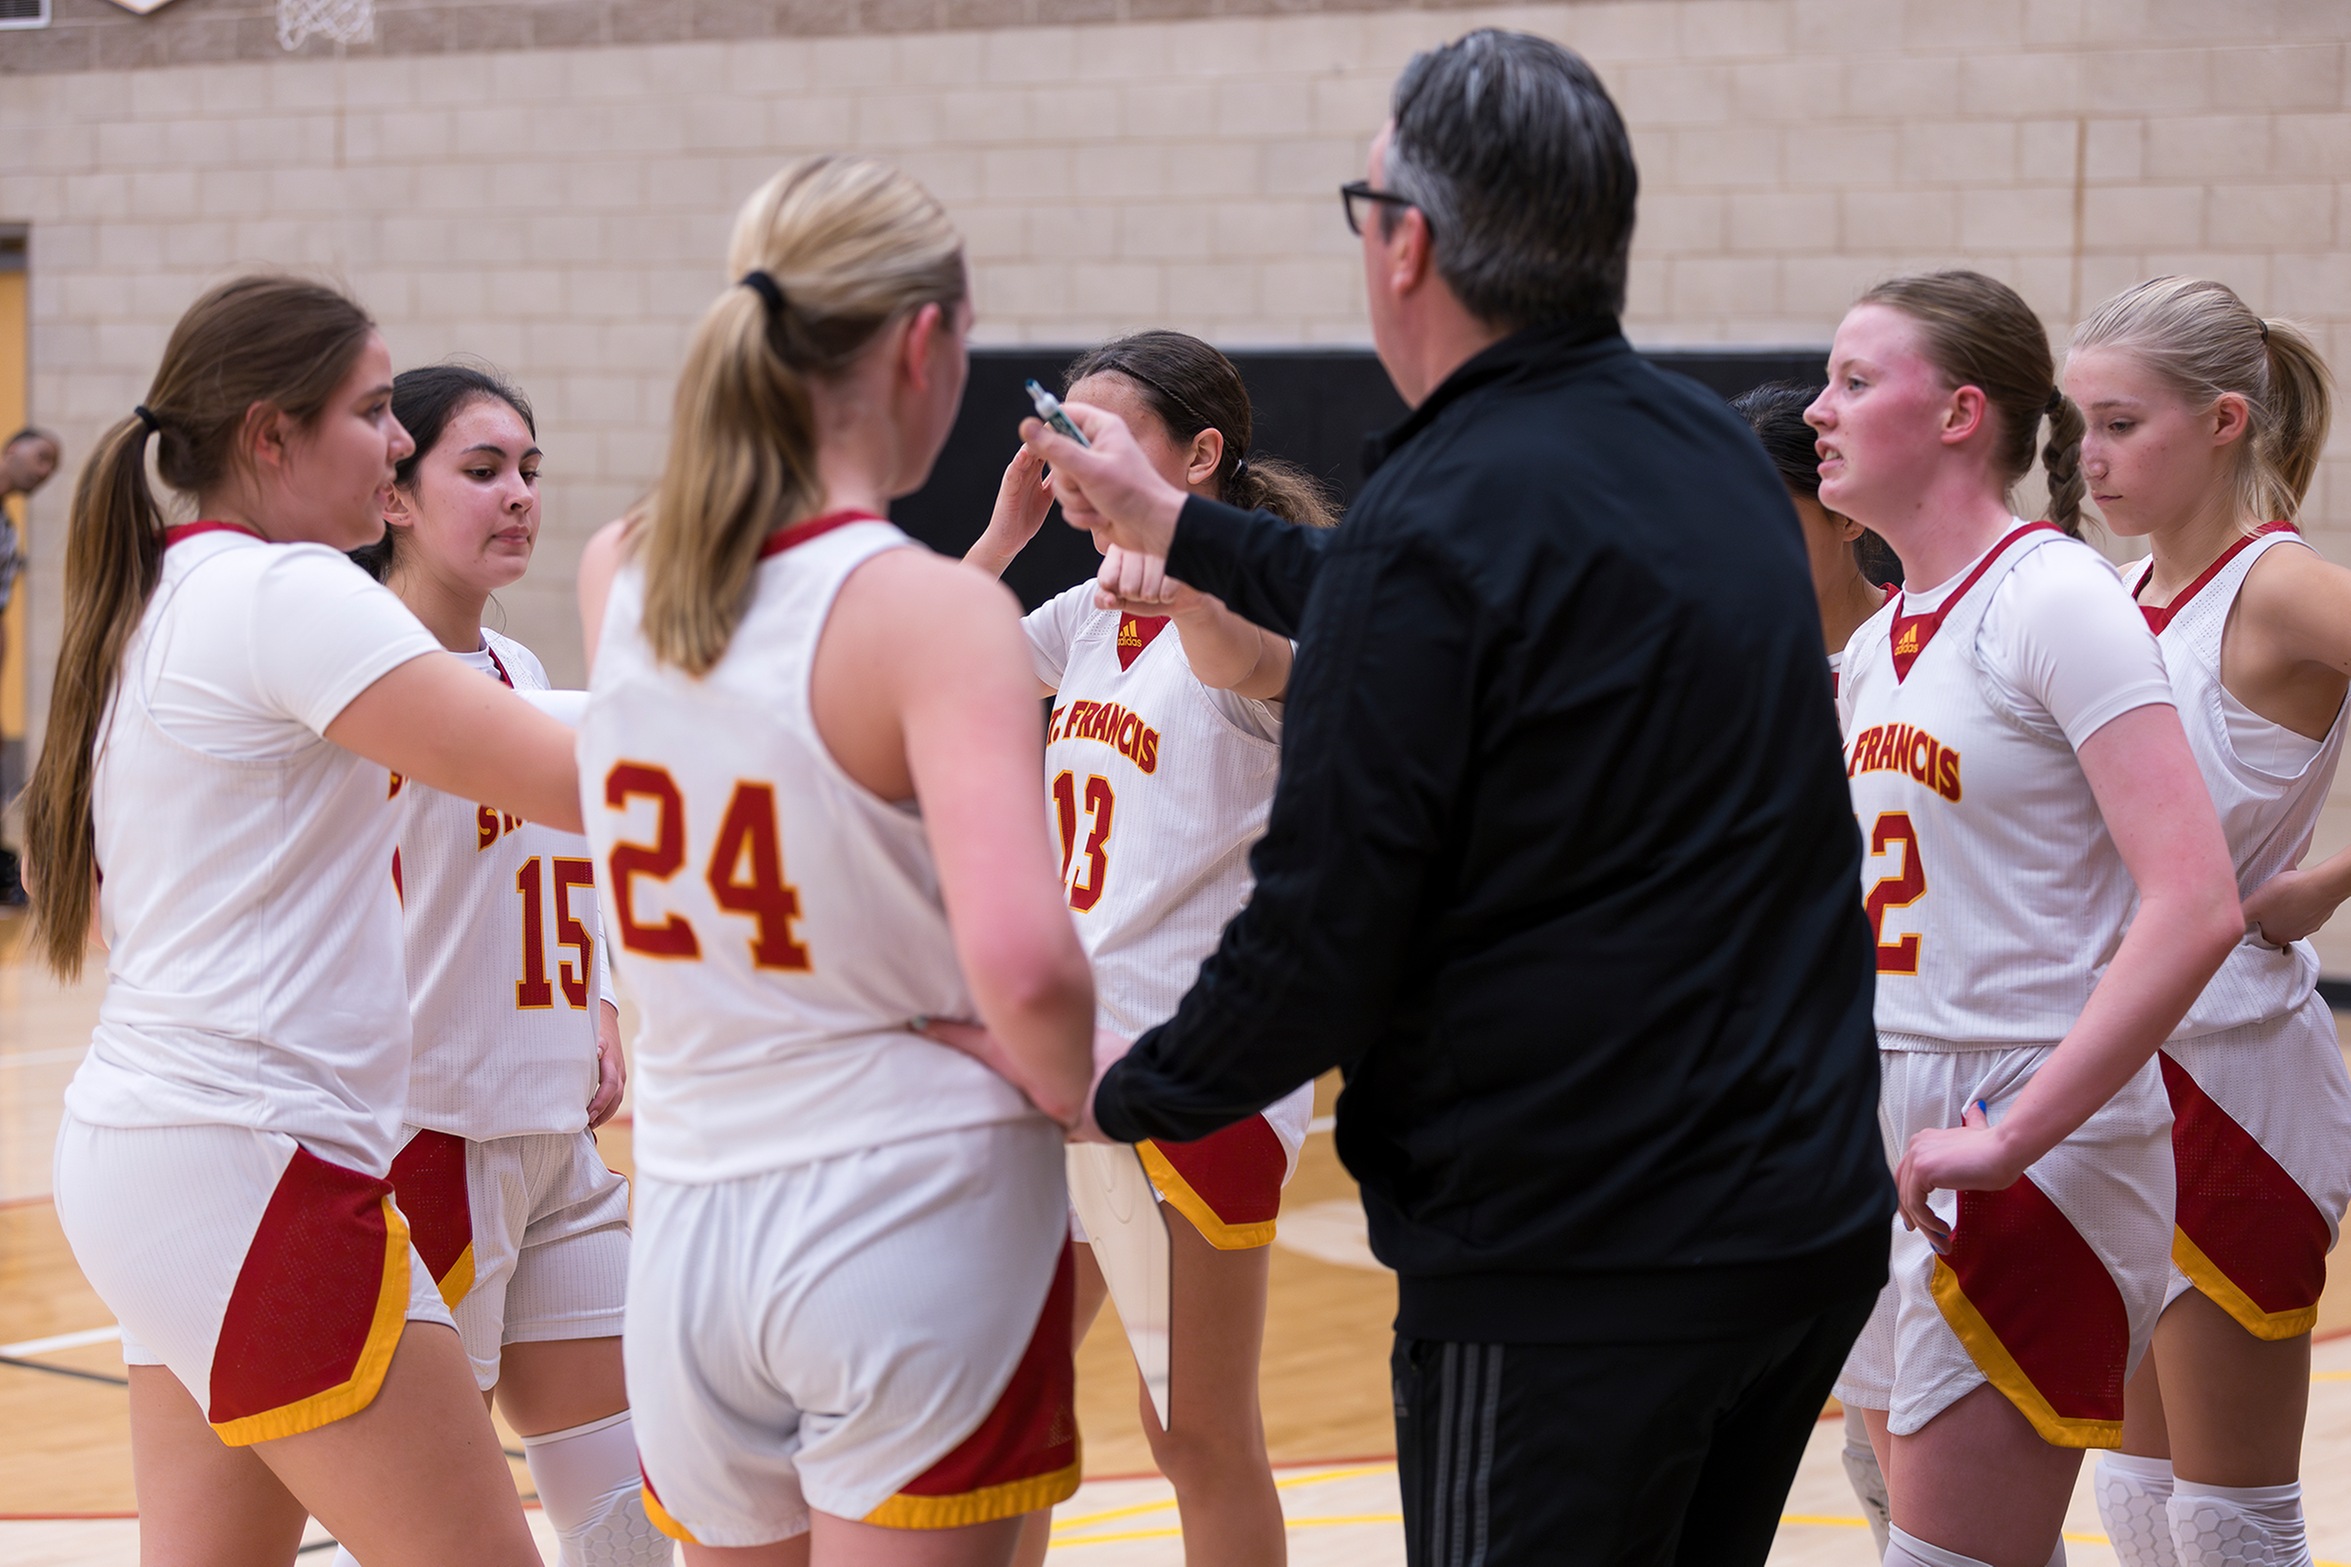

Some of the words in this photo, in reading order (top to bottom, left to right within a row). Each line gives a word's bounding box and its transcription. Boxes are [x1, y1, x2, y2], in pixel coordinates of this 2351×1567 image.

[1062, 700, 1160, 776] FRANCIS
[1847, 721, 1962, 804] FRANCIS
[604, 758, 814, 974] 24
[1053, 769, 1116, 914] 13
[1863, 810, 1928, 976] 2
[516, 855, 595, 1010] 15
